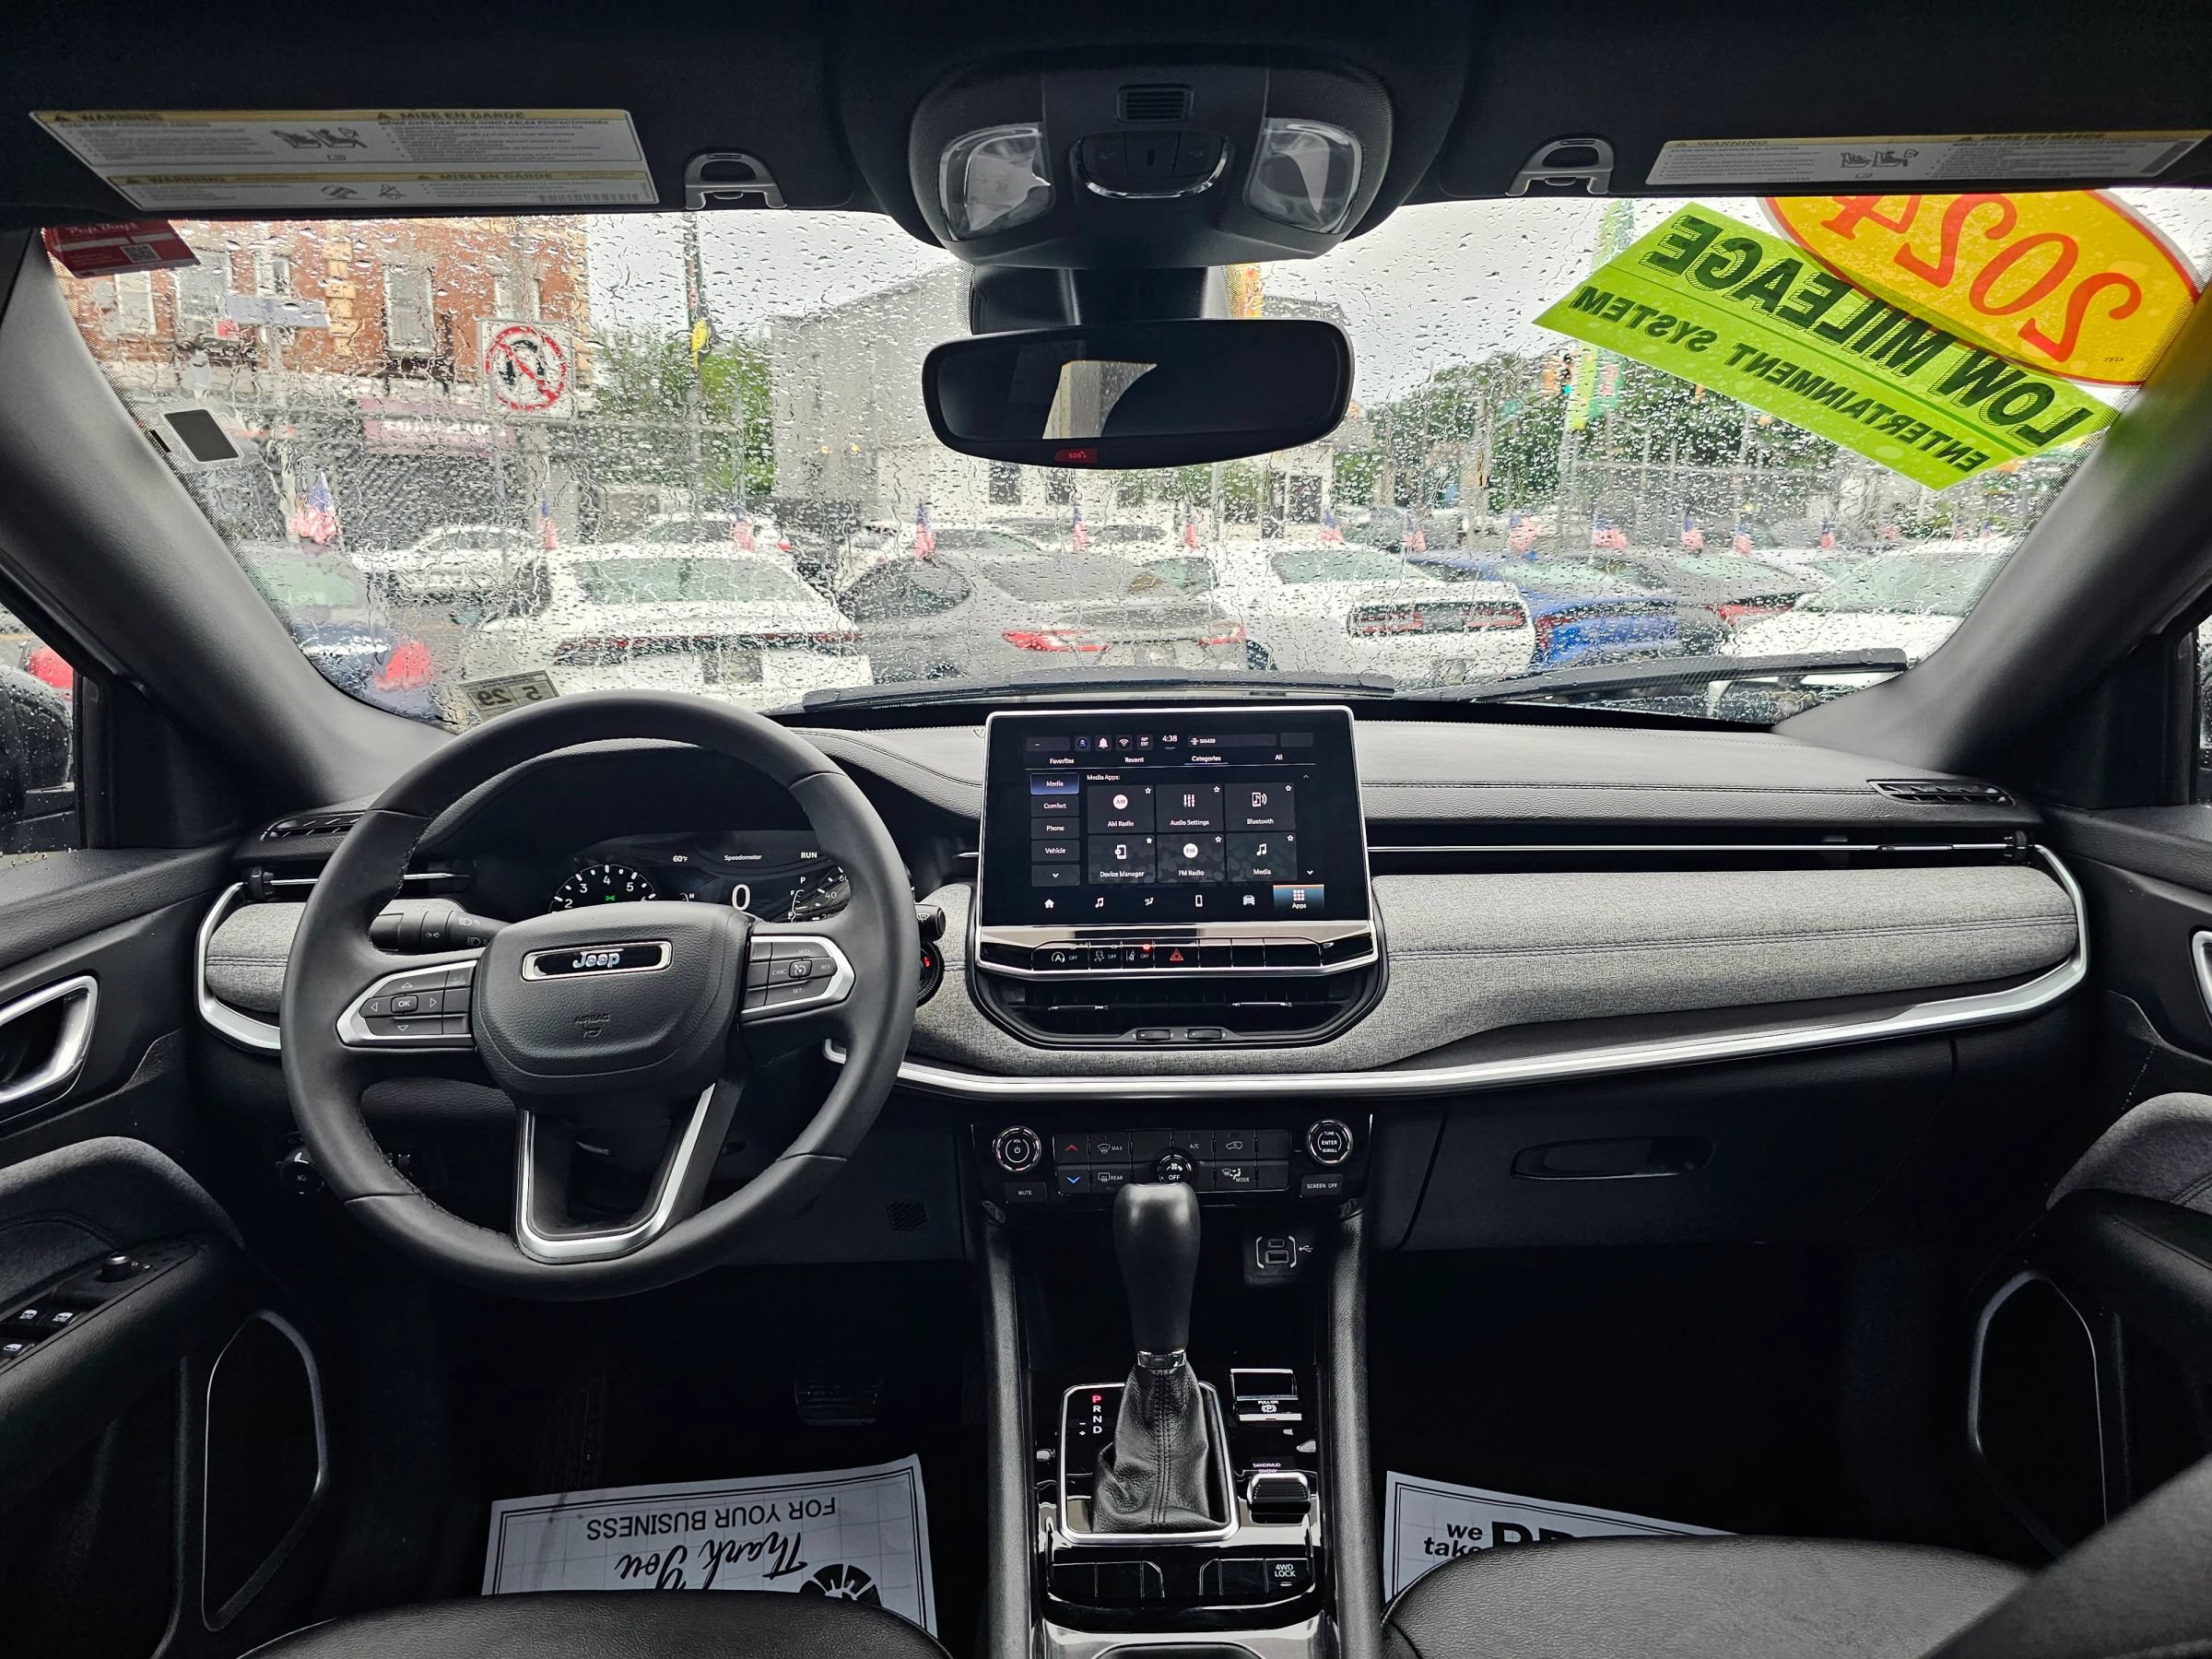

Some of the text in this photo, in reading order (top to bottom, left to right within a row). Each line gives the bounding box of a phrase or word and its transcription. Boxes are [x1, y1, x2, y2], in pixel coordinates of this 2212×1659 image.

[1161, 734, 1178, 743] 4:38
[1049, 756, 1076, 765] Favorites
[1124, 756, 1145, 764] Recent
[1191, 754, 1222, 764] Categories
[1274, 753, 1284, 761] All
[1087, 773, 1121, 782] Media Apps:
[1046, 780, 1064, 788] Media
[1043, 802, 1067, 810] Comfort
[1118, 819, 1135, 828] Radio
[1170, 818, 1210, 828] Audio Settings
[1246, 818, 1275, 826] Bluetooth
[1044, 846, 1066, 854] Vehicle
[724, 853, 763, 862] Speedometer
[800, 851, 818, 860] RUN
[1100, 870, 1145, 879] Device Manager
[1178, 869, 1205, 877] FM Radio
[1253, 868, 1272, 877] Media
[602, 875, 612, 886] 4
[579, 883, 589, 894] 3
[626, 881, 635, 892] 5
[731, 882, 751, 912] 0
[824, 890, 838, 900] 40
[1291, 901, 1308, 911] Apps
[571, 950, 620, 971] Jeep
[397, 998, 411, 1008] OK
[1091, 1394, 1102, 1403] P
[1092, 1404, 1102, 1414] R
[1092, 1415, 1102, 1424] N
[1092, 1425, 1103, 1435] D
[586, 1495, 837, 1541] FOR YOUR BUSINESS
[1445, 1522, 1484, 1542] we
[613, 1530, 810, 1591] Thank You
[1275, 1563, 1294, 1571] 4WD
